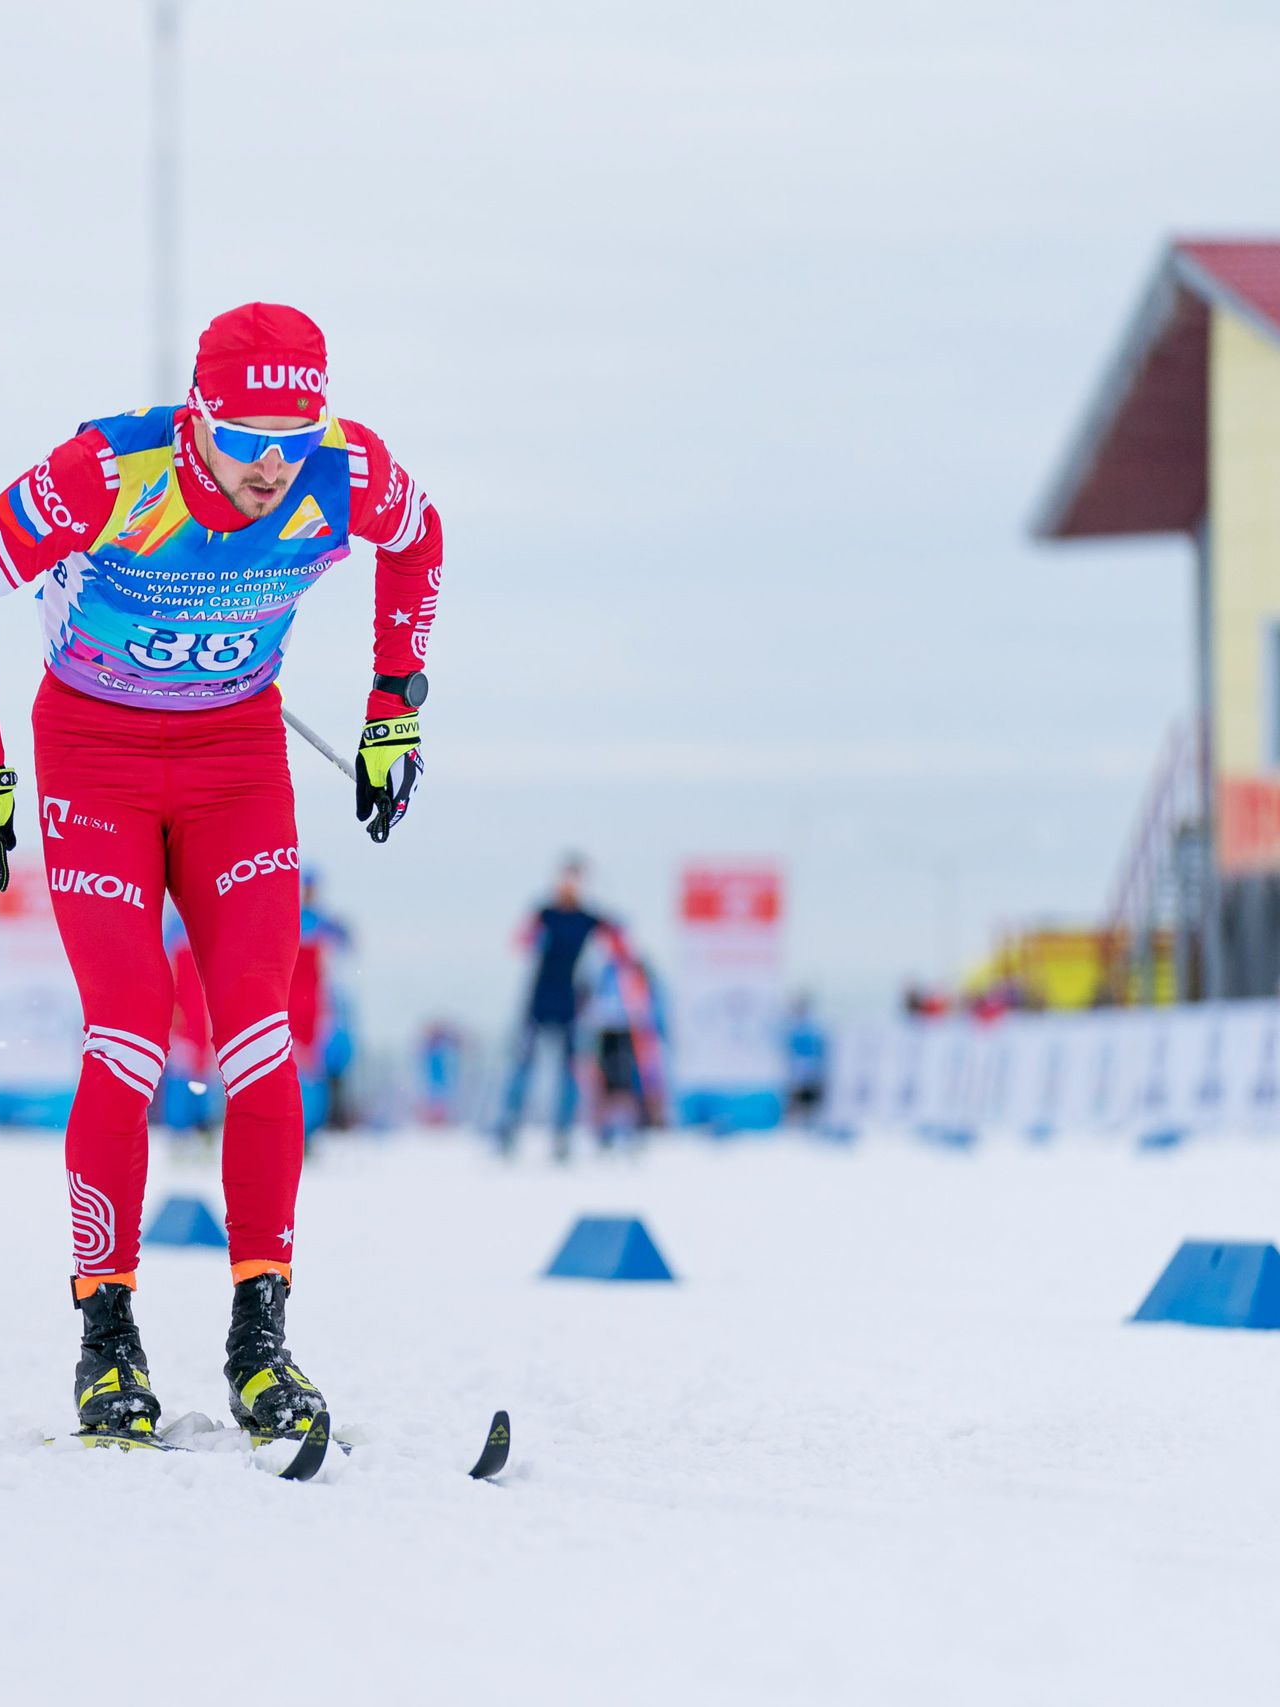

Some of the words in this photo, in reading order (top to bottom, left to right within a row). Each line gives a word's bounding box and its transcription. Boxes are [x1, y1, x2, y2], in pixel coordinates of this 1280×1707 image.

[34, 454, 72, 528] OSCO
[220, 571, 238, 580] по
[242, 556, 334, 580] физической
[147, 583, 216, 595] культуре
[220, 585, 230, 593] и
[234, 581, 287, 593] спорту
[209, 596, 250, 607] Саха
[175, 610, 258, 621] АЛДАН
[124, 624, 265, 672] 38
[72, 814, 118, 834] RUSAL
[215, 846, 300, 897] BOSCO
[51, 867, 145, 910] LUKOIL
